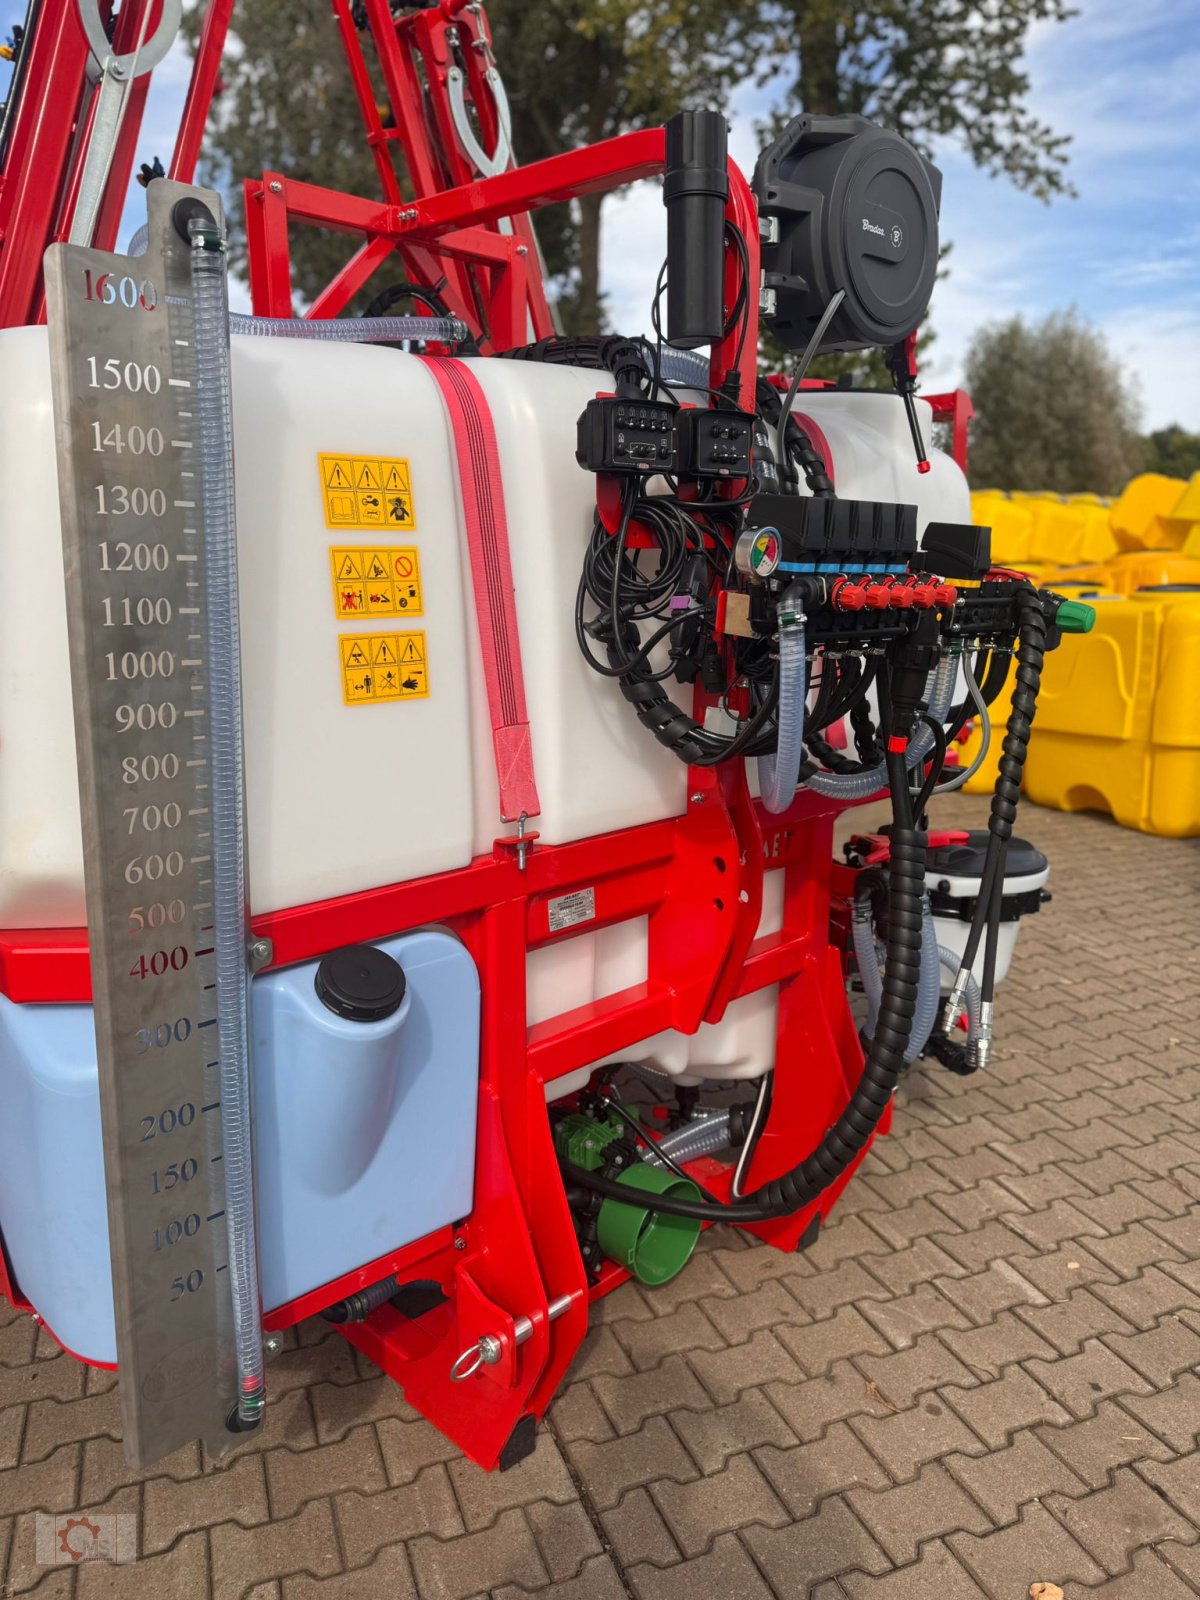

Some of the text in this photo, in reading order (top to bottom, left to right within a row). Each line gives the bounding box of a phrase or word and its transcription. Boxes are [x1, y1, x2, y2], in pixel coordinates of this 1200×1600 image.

[82, 269, 158, 312] 1600
[87, 356, 161, 394] 1500
[91, 421, 164, 456] 1400
[95, 484, 167, 517] 1300
[98, 541, 169, 571] 1200
[101, 597, 172, 626] 1100
[105, 651, 174, 680] 1000
[115, 702, 177, 733] 900
[122, 753, 179, 784] 800
[122, 802, 181, 834] 700
[124, 851, 184, 884] 600
[127, 899, 186, 934] 500
[129, 946, 189, 980] 400
[135, 1017, 192, 1055] 300
[140, 1103, 195, 1142] 200
[152, 1158, 199, 1195] 150
[153, 1213, 201, 1252] 100
[170, 1269, 204, 1302] 50
